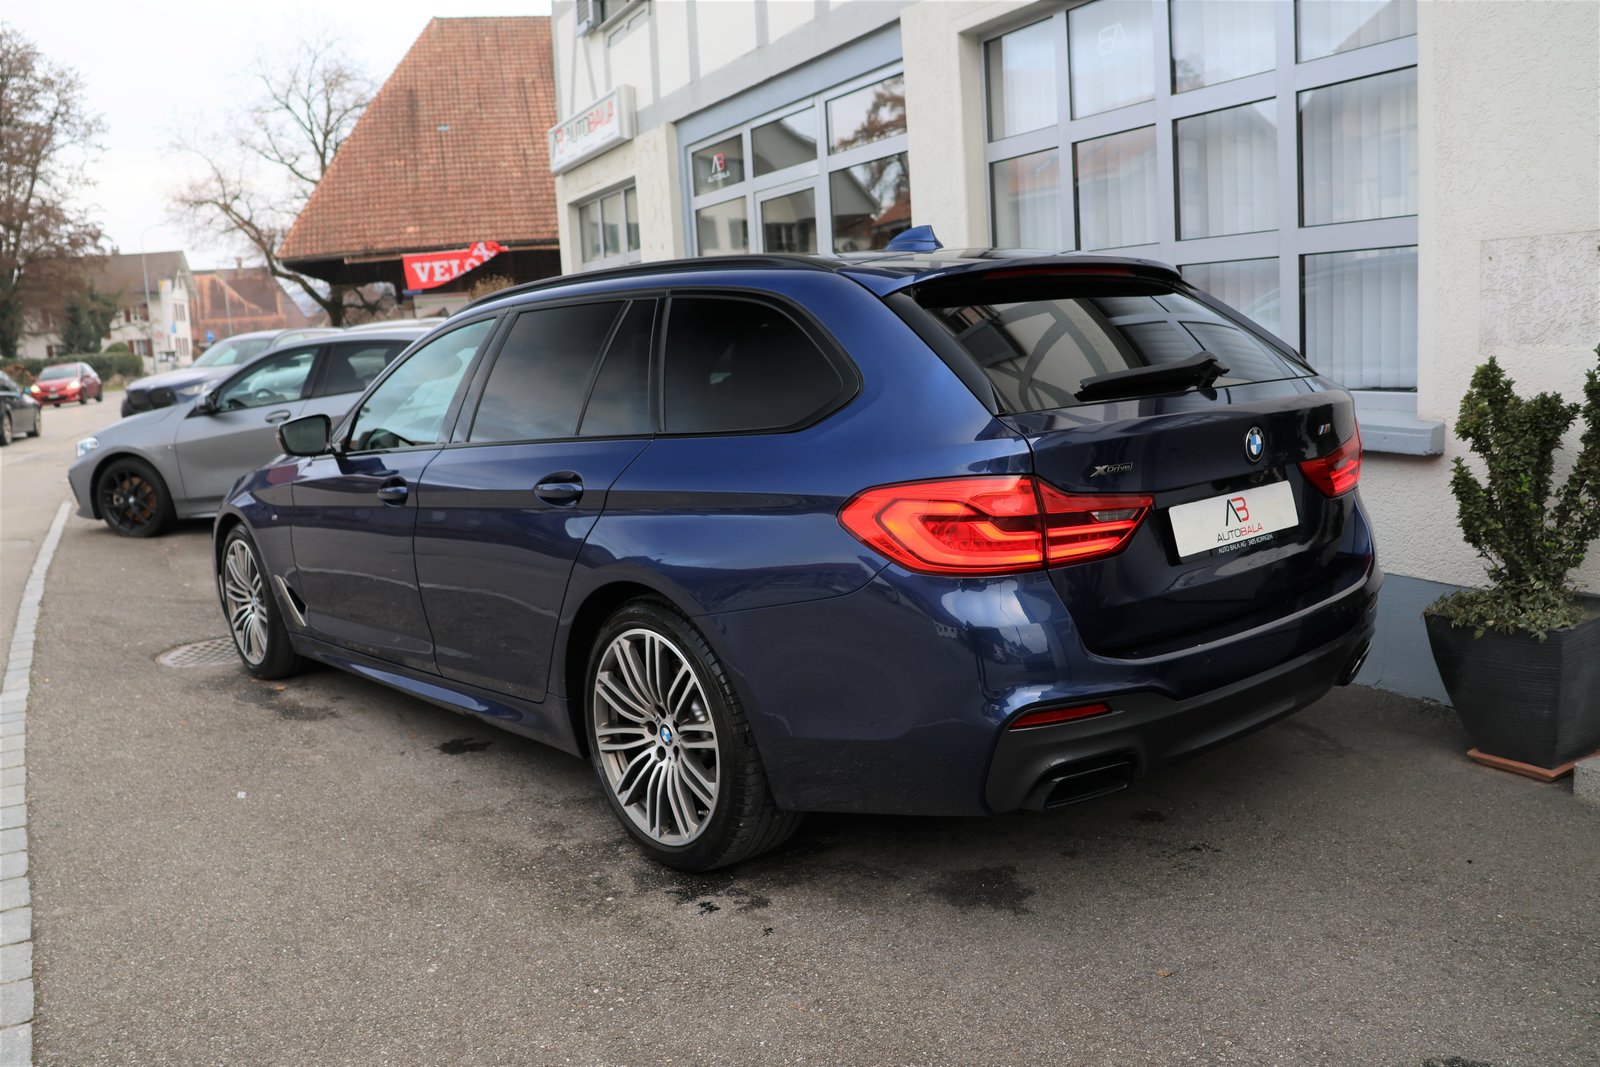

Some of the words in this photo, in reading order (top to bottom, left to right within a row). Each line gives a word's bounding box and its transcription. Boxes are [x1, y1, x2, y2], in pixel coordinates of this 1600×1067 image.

[1225, 496, 1250, 526] AB
[1216, 522, 1264, 543] AUTOBALA
[1218, 545, 1230, 554] AUTO
